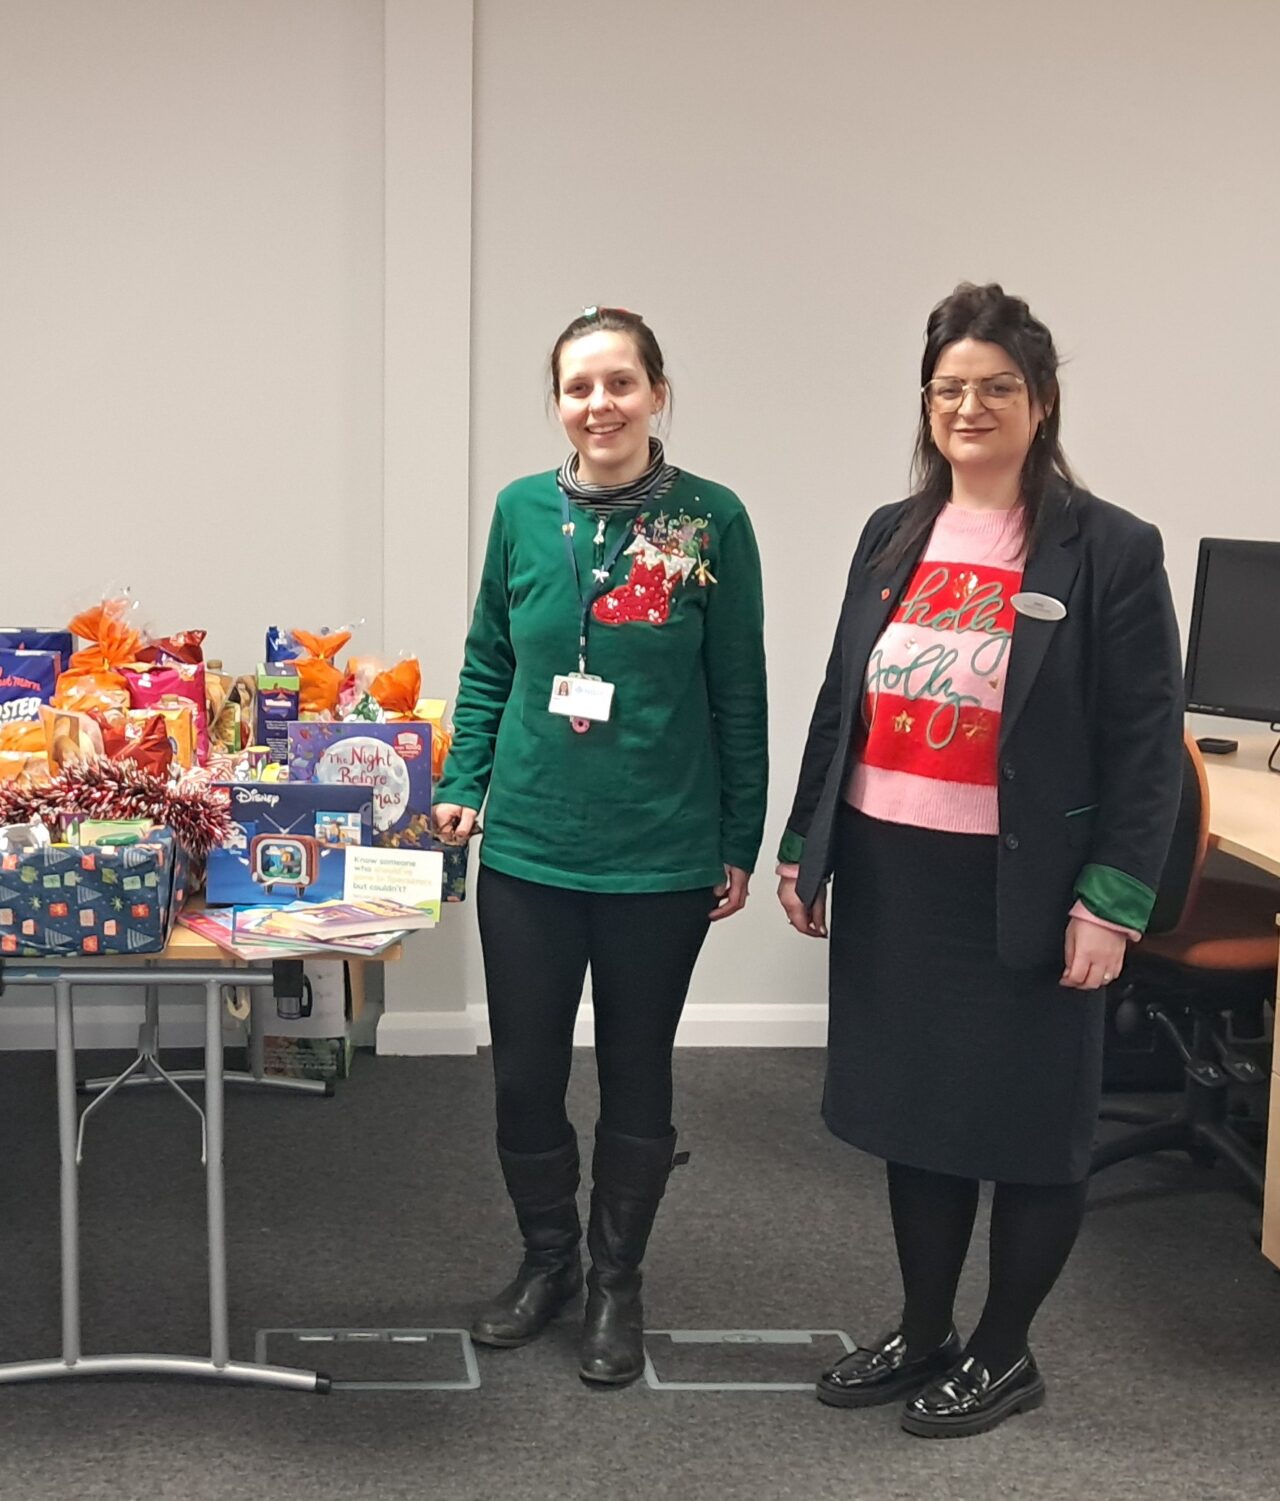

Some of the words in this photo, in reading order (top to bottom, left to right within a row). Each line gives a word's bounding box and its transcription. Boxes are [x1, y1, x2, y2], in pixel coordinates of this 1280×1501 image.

[900, 567, 1012, 676] holly
[327, 752, 347, 765] The
[347, 744, 393, 771] Night
[336, 766, 388, 784] Before
